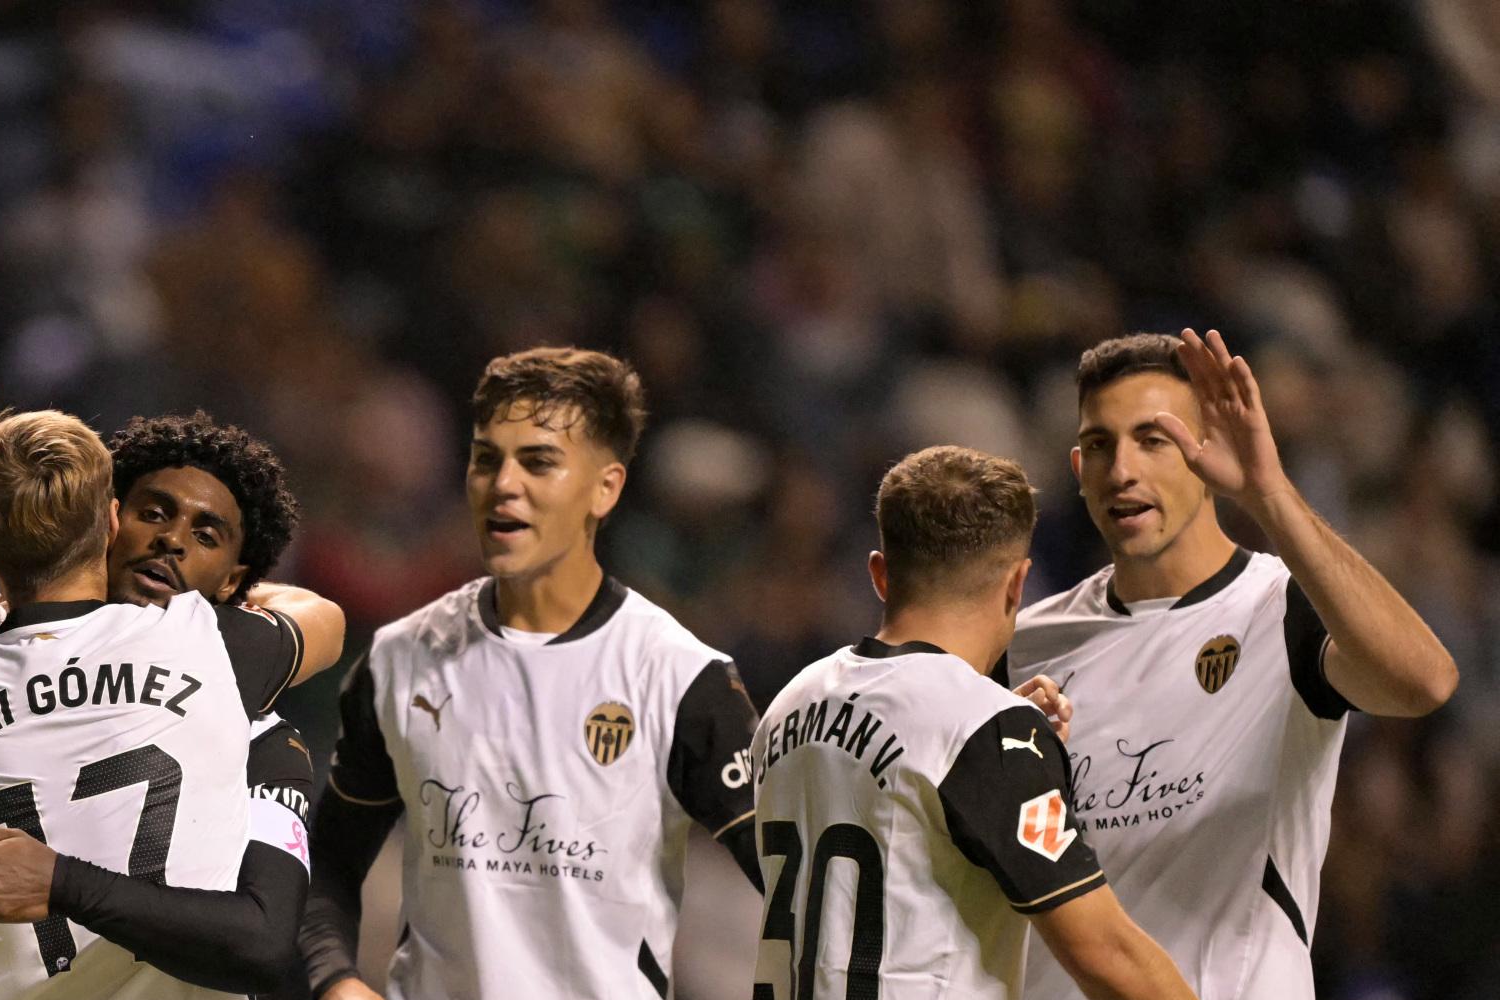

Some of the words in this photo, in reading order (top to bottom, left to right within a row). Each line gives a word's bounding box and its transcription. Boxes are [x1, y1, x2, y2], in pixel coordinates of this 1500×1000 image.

[26, 657, 202, 717] GÓMEZ
[870, 733, 905, 789] V.
[1069, 752, 1101, 813] he
[420, 779, 490, 849] The
[497, 782, 608, 861] Fives
[1095, 814, 1140, 831] MAYA
[486, 859, 533, 874] MAYA
[539, 863, 605, 882] HOTELS
